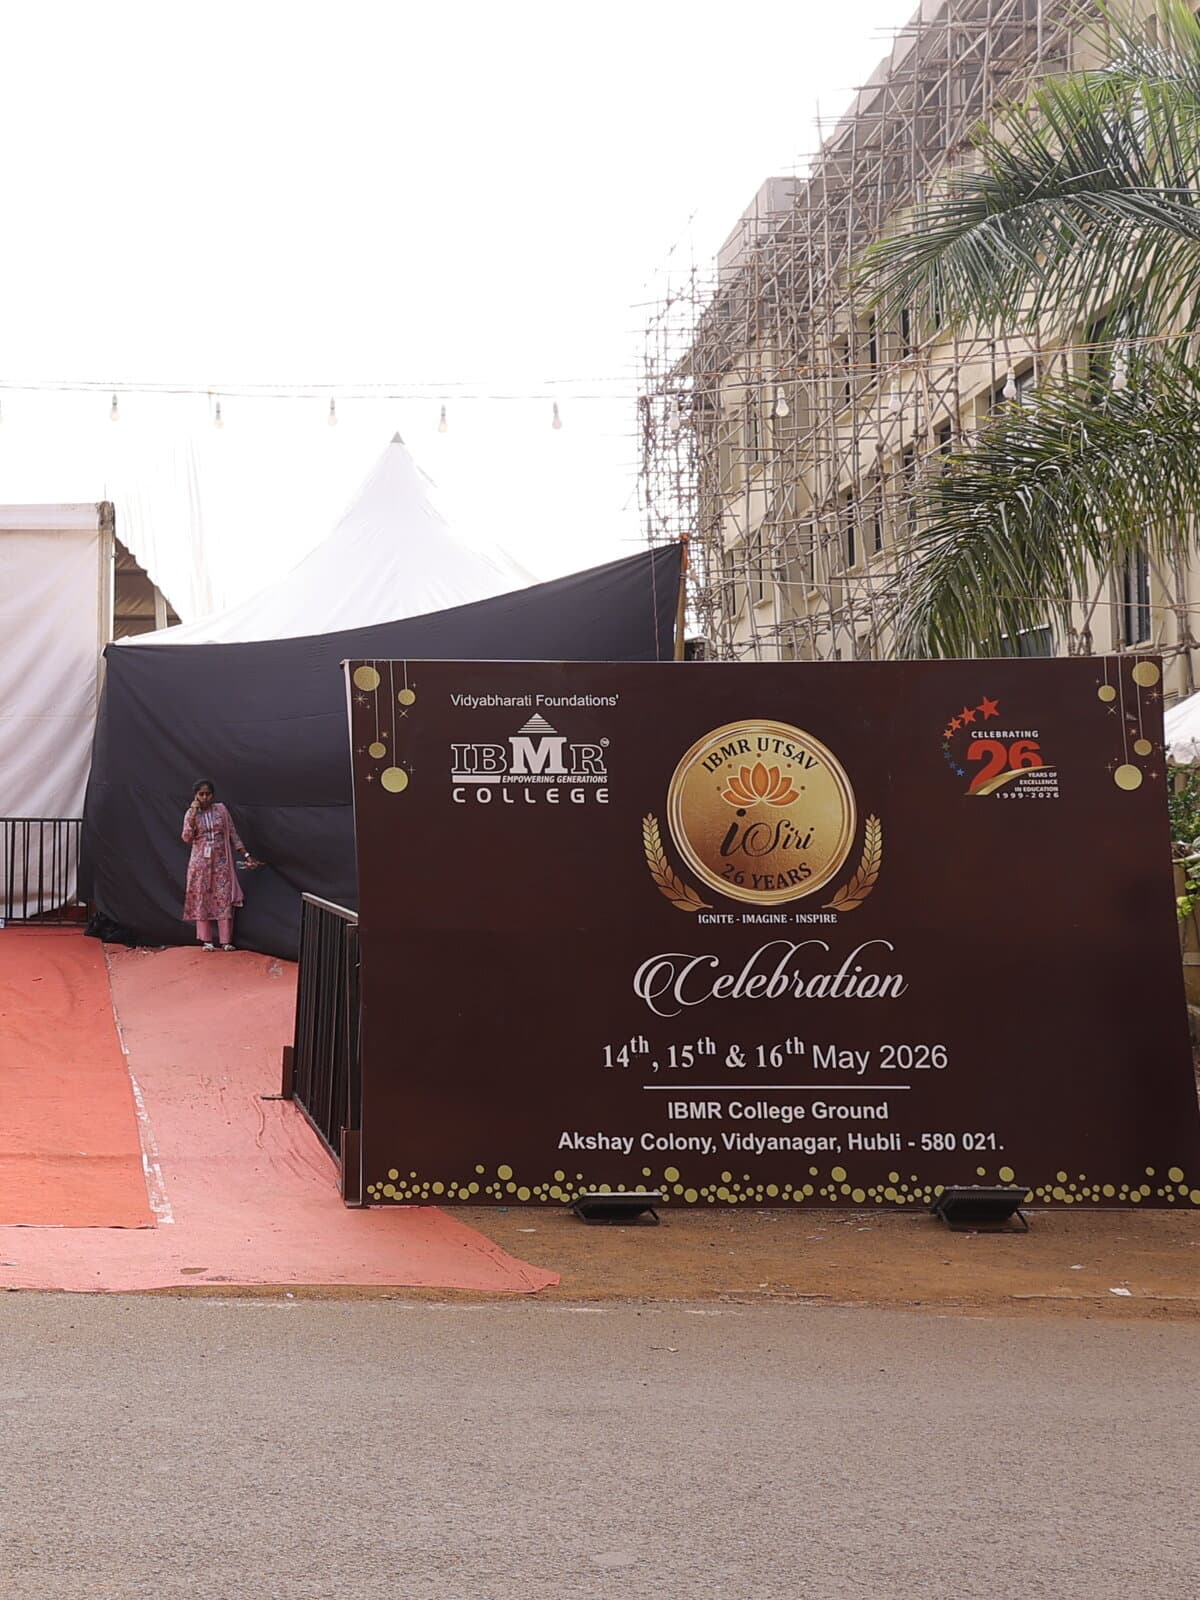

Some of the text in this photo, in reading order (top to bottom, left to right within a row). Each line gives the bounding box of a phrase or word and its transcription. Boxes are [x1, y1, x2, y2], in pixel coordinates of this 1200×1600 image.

[450, 694, 619, 709] Vidyabharati Foundations'
[451, 736, 608, 774] IBMR
[701, 737, 819, 773] IBMR UTSAV
[967, 739, 1044, 793] 26
[502, 775, 608, 783] EMPOWERING GENERATIONS
[452, 788, 609, 804] COLLEGE
[720, 862, 812, 890] 26 YEARS
[698, 914, 734, 924] IGNITE
[742, 914, 788, 924] IMAGINE
[796, 914, 838, 924] INSPIRE
[633, 939, 908, 1017] Celebration
[668, 1037, 717, 1068] 15th
[725, 1045, 747, 1068] &
[756, 1037, 806, 1068] 16th
[812, 1045, 870, 1075] May
[879, 1045, 949, 1069] 2026
[668, 1101, 888, 1123] IBMR College Ground
[558, 1133, 634, 1155] Akshay
[640, 1132, 717, 1155] Colony,
[721, 1133, 842, 1155] Vidyanagar,
[848, 1133, 901, 1151] Hubli
[921, 1133, 956, 1151] 580
[962, 1133, 1004, 1151] 021.
